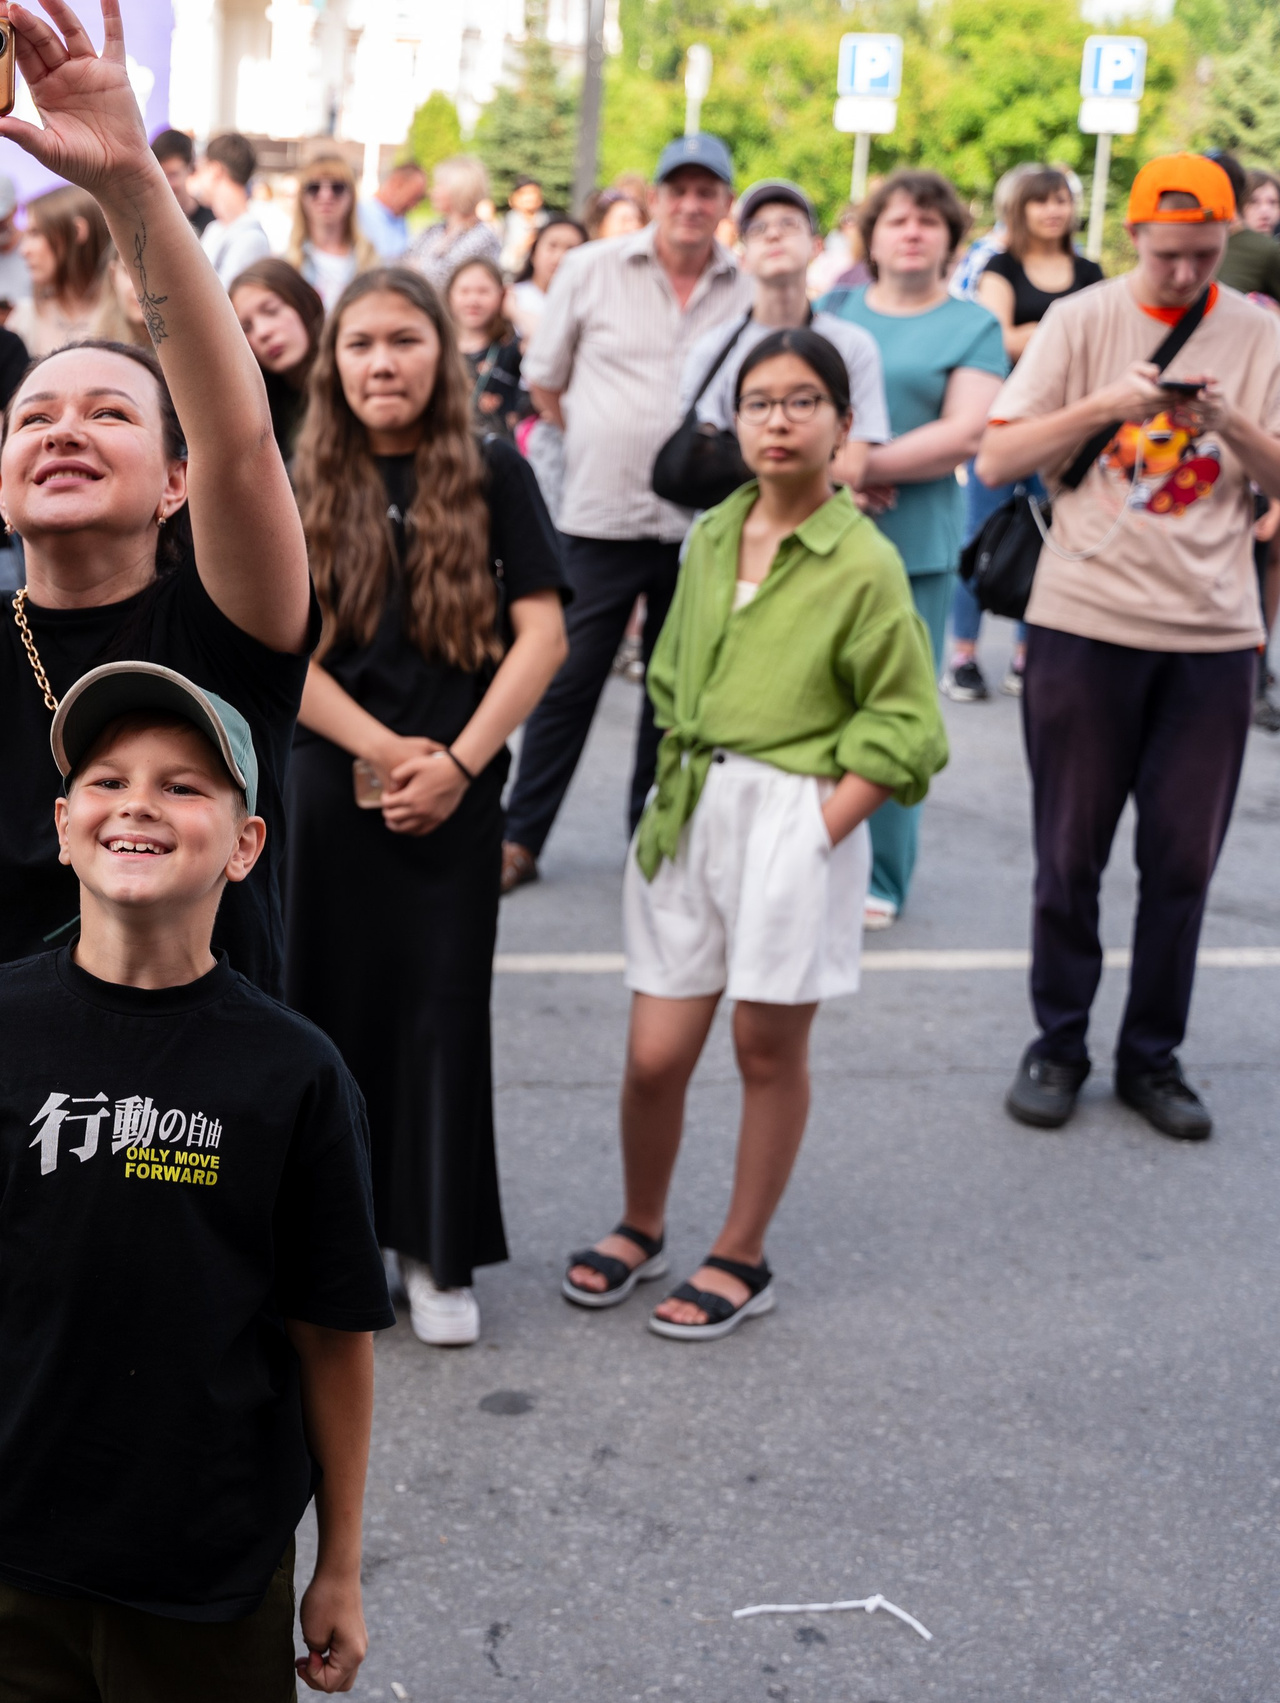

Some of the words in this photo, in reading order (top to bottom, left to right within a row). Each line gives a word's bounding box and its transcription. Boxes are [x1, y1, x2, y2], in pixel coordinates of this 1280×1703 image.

[28, 1091, 223, 1176] 行動の自由
[126, 1146, 170, 1163] ONLY
[174, 1151, 220, 1170] MOVE
[124, 1162, 218, 1186] FORWARD
